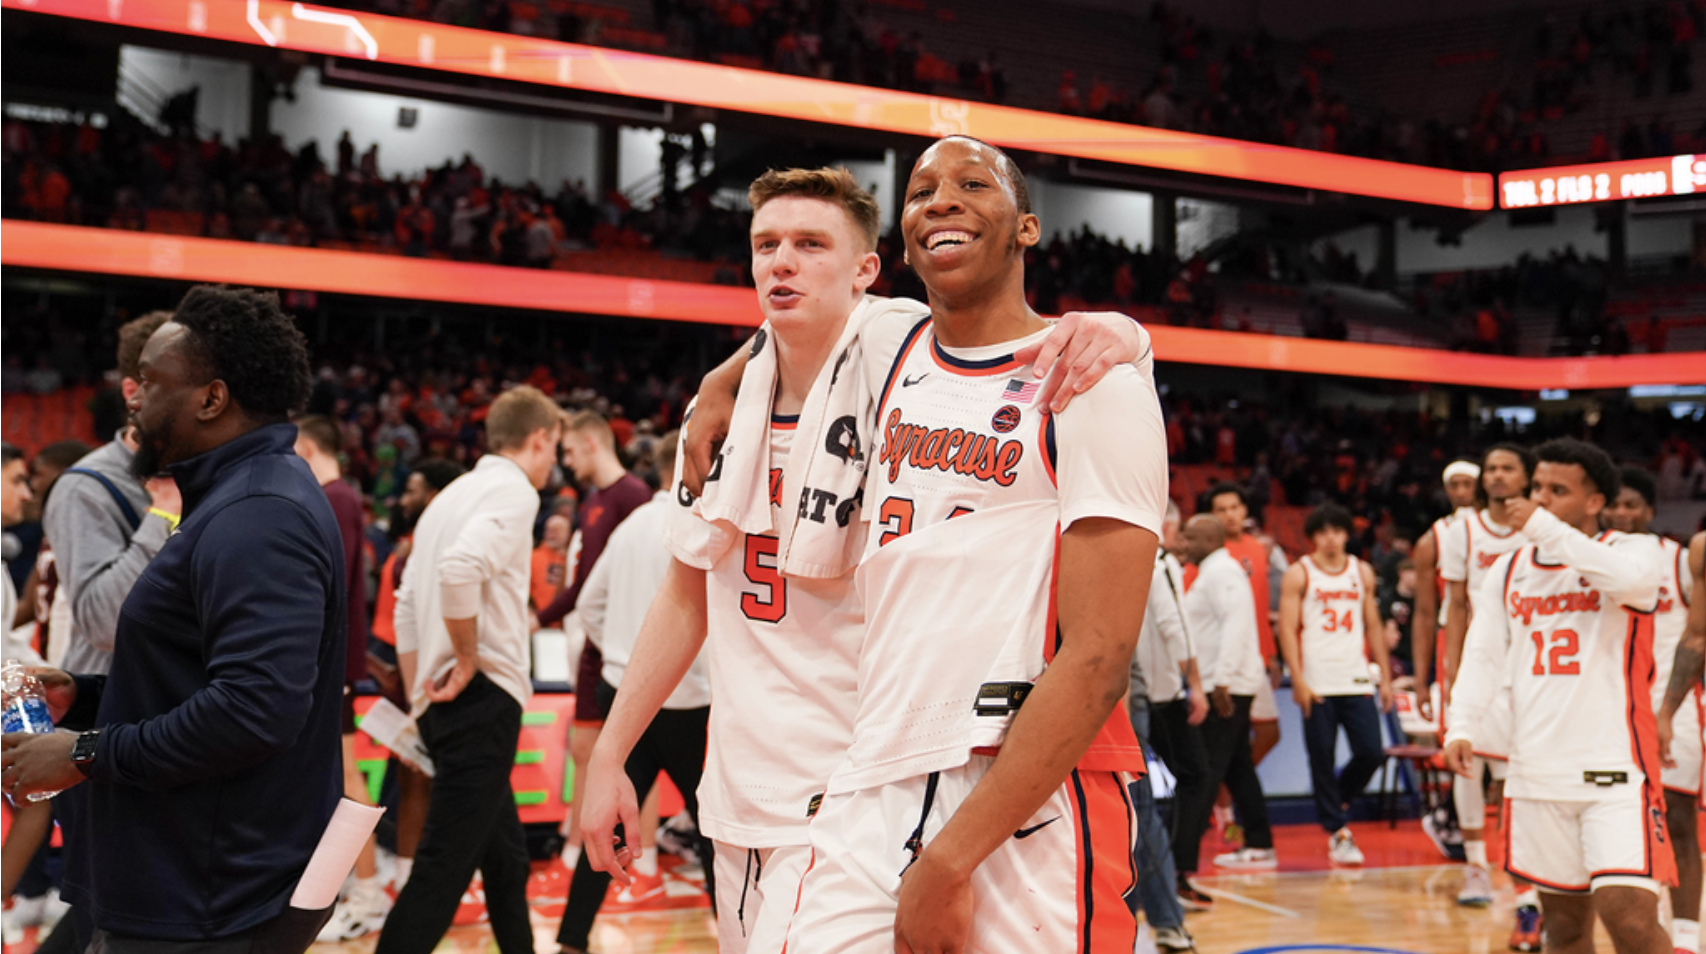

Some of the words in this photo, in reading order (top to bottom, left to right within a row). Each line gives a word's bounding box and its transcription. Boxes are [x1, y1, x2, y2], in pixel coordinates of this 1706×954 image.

[1540, 178, 1555, 204] 2
[1595, 173, 1610, 199] 2
[879, 407, 1023, 487] Syracuse
[740, 533, 787, 623] 5
[1322, 609, 1353, 633] 34
[1510, 590, 1601, 626] Syracuse
[1531, 628, 1581, 676] 12
